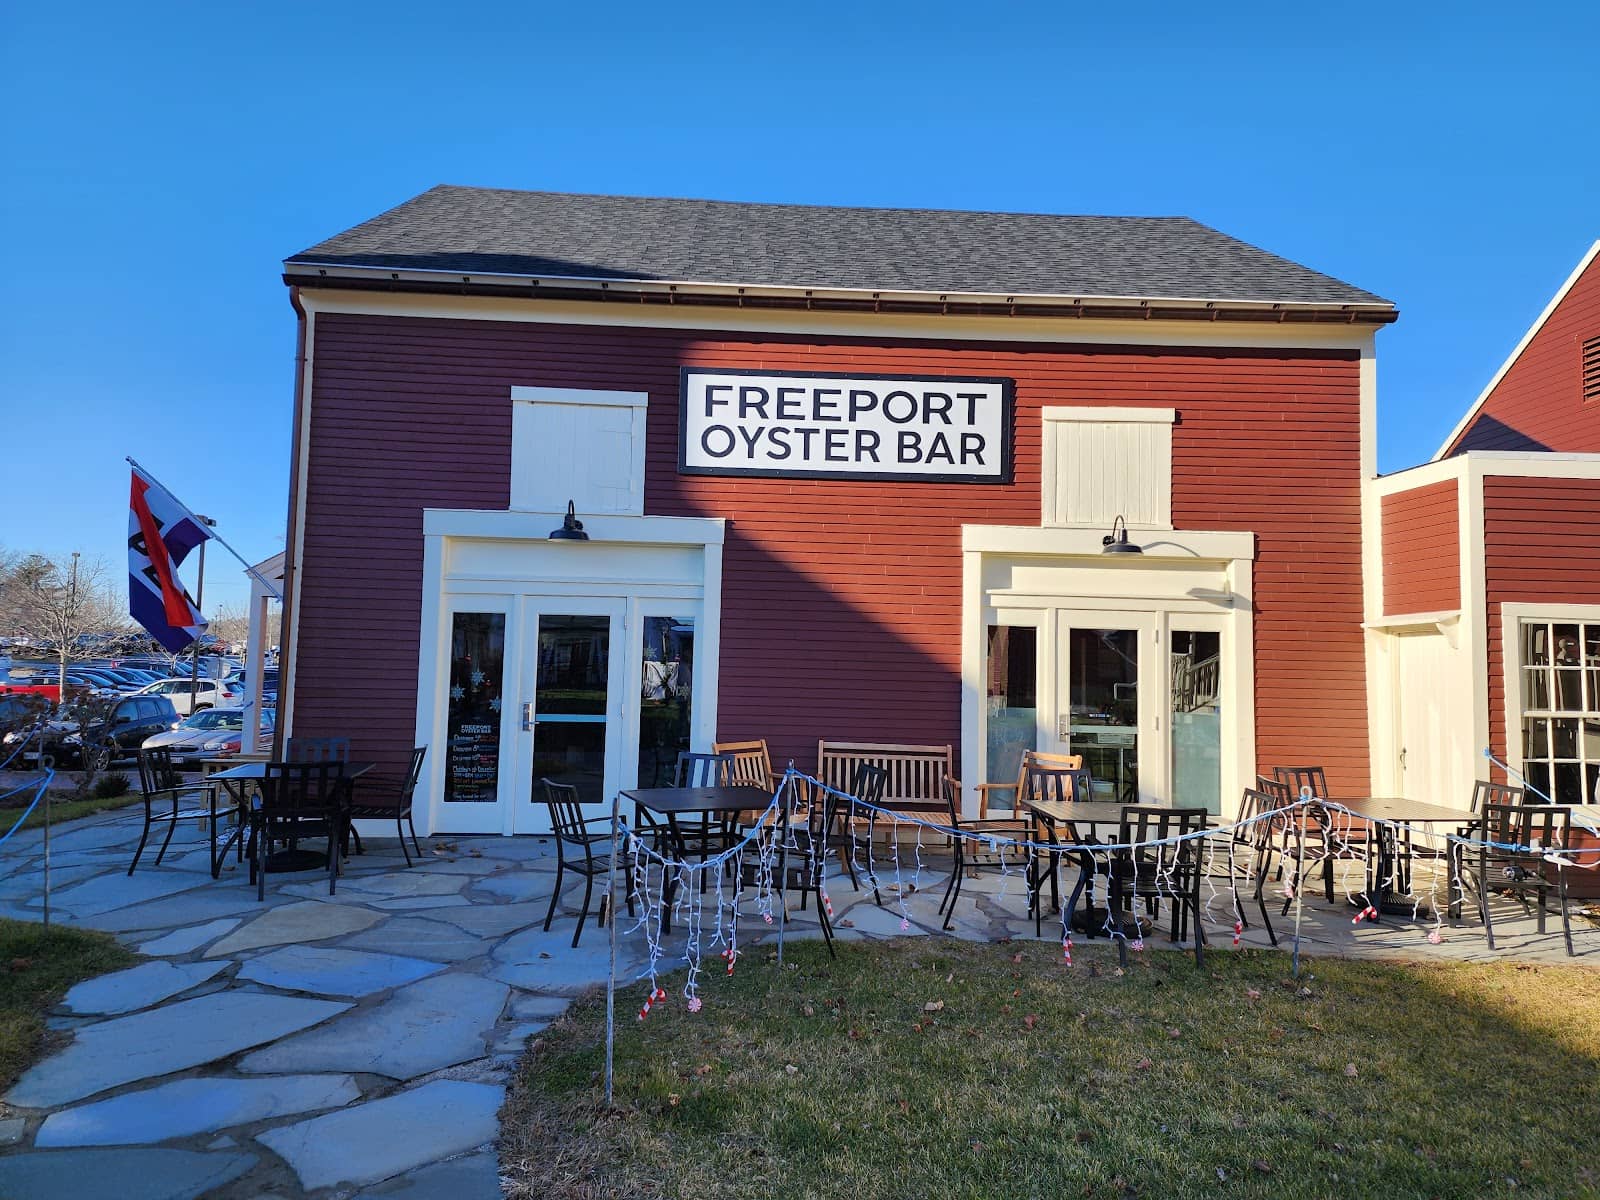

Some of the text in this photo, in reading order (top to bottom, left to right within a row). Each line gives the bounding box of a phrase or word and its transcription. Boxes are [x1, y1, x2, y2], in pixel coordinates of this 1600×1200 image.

[704, 384, 988, 426] FREEPORT
[700, 424, 987, 466] OYSTER BAR
